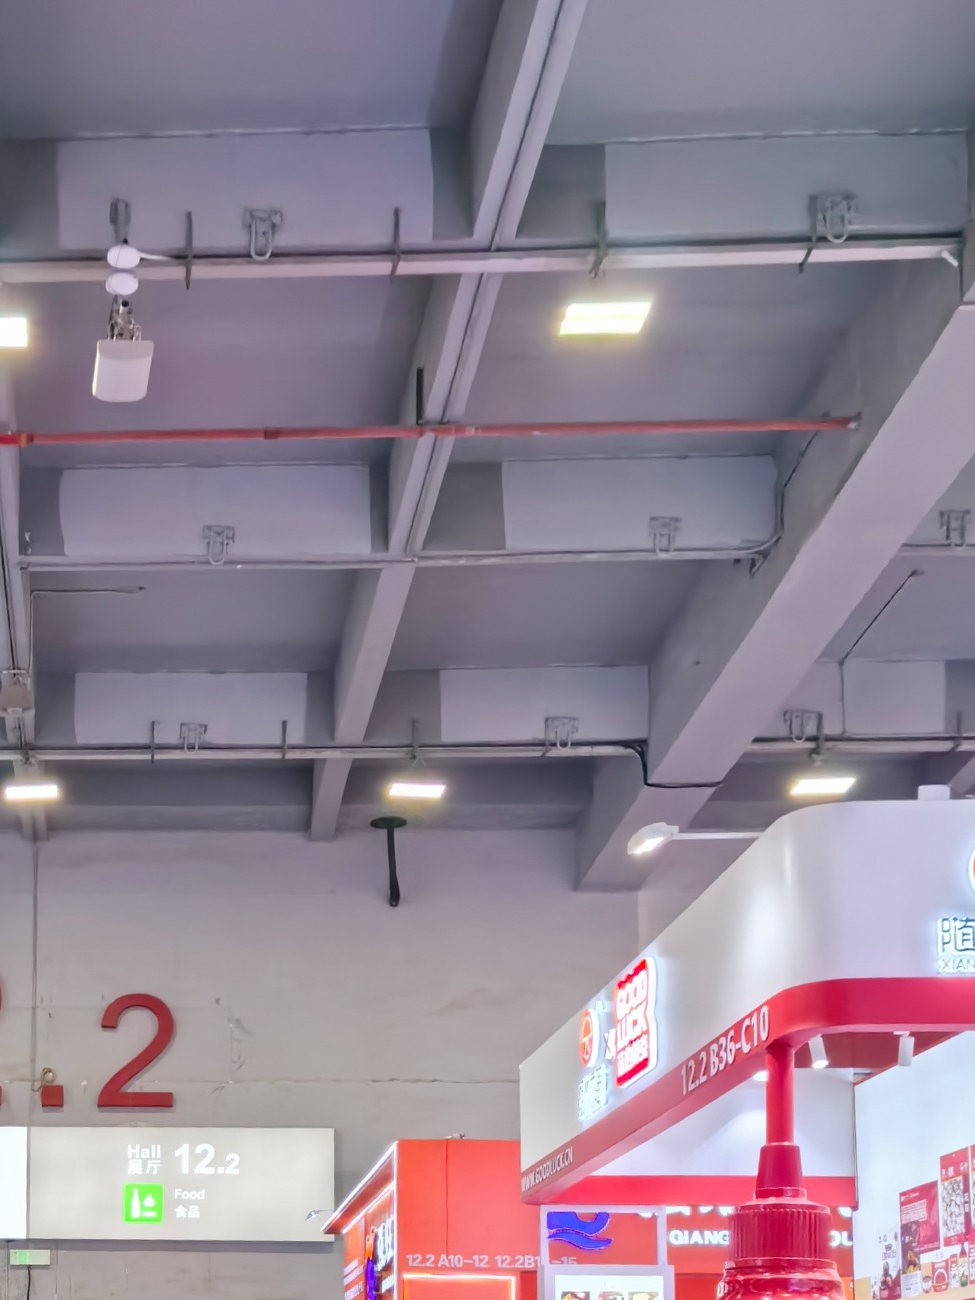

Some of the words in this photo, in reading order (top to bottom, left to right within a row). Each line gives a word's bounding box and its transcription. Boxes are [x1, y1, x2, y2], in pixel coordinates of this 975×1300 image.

[616, 970, 647, 1020] GOOD
[616, 1003, 648, 1051] LUCK
[681, 1058, 707, 1095] 12.2
[709, 1005, 769, 1077] B36-C10
[127, 1144, 161, 1159] Hall
[175, 1143, 240, 1175] 12.2
[127, 1159, 161, 1175] 展厅
[175, 1189, 205, 1200] Food
[175, 1205, 200, 1218] 食品
[406, 1254, 434, 1267] 12.2
[438, 1254, 489, 1267] A10-12
